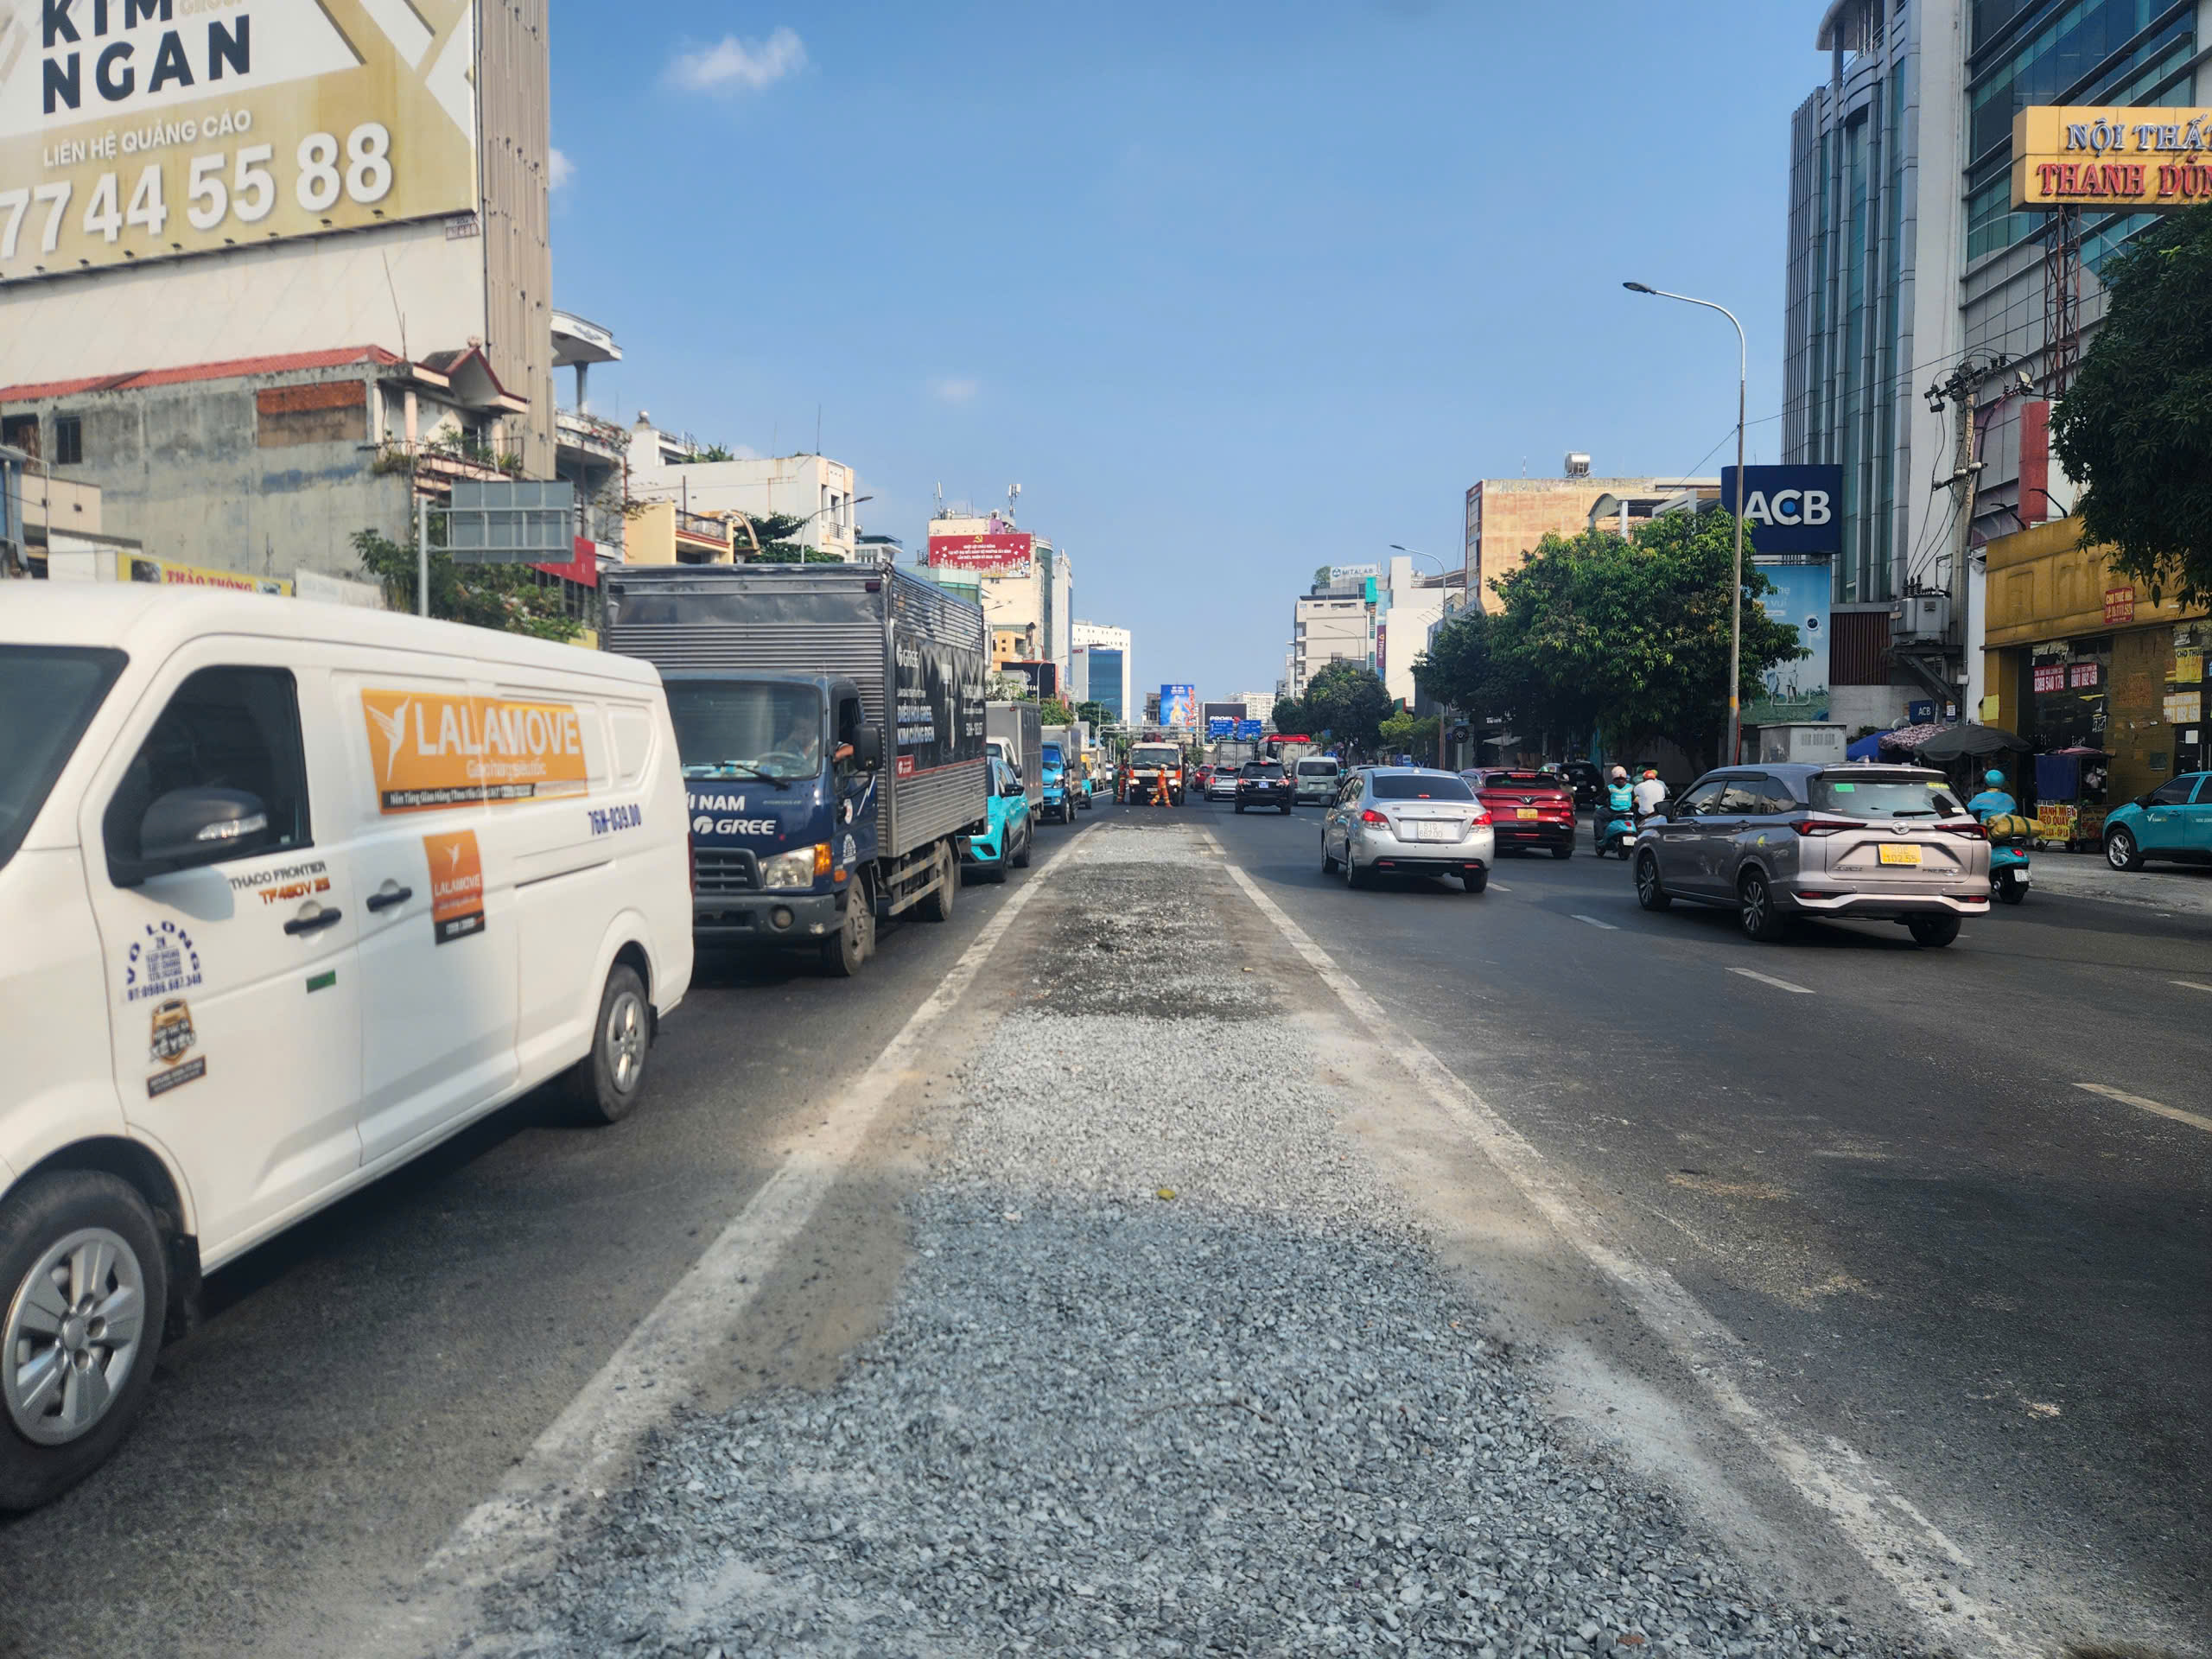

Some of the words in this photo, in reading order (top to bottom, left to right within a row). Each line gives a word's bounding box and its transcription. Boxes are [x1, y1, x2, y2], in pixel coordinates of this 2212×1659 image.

[42, 14, 250, 114] NGAN
[44, 139, 86, 167] LIÊN
[91, 130, 118, 160] HỆ
[122, 119, 198, 153] QUẢNG
[202, 108, 252, 137] CÁO
[2066, 118, 2126, 157] NỘI
[2132, 112, 2212, 149] THẤ
[187, 143, 275, 230] 55
[296, 123, 392, 213] 88
[2037, 162, 2146, 197] THANH
[1742, 489, 1832, 525] ACB
[903, 649, 918, 668] GREE
[1918, 706, 1931, 716] ACB
[415, 702, 581, 756] LALAMOVE
[698, 795, 745, 811] NAM
[715, 820, 777, 836] GREE
[2053, 817, 2069, 825] QUAY
[229, 871, 272, 891] THACO
[273, 860, 327, 880] FRONTIER
